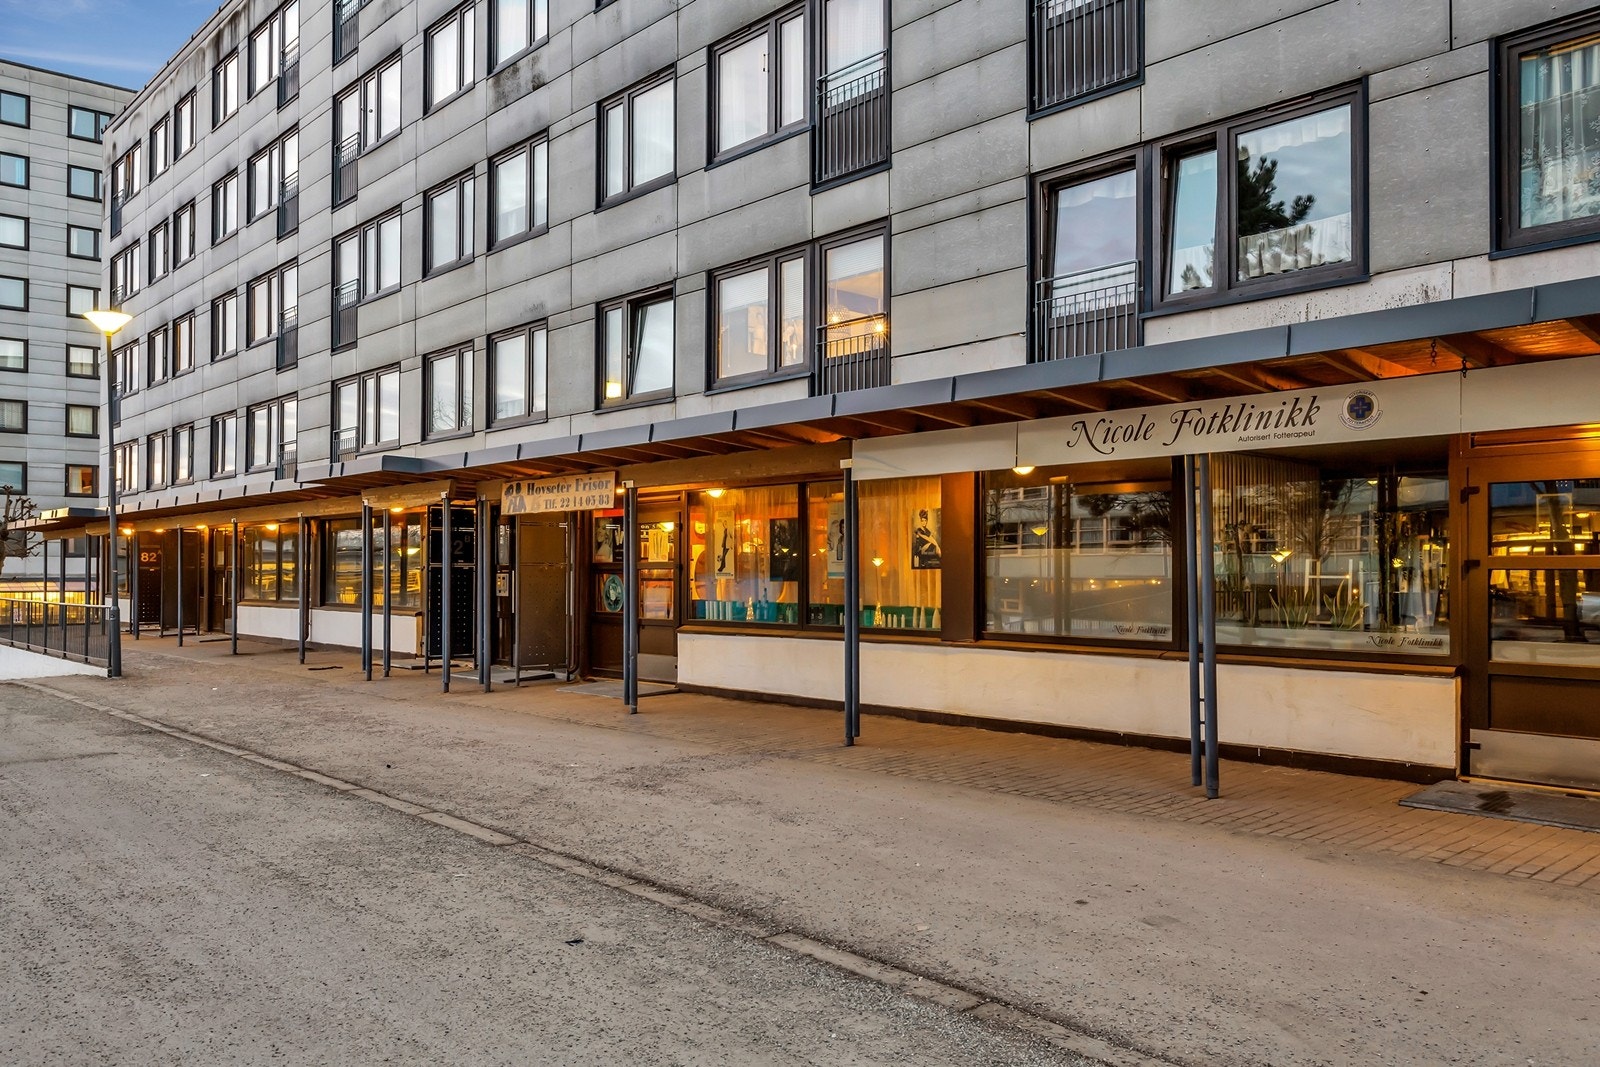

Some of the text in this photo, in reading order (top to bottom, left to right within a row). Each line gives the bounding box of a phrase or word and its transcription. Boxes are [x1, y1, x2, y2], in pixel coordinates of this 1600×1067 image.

[1066, 413, 1156, 455] Nicole
[1162, 395, 1321, 447] Fotklinikk
[1237, 430, 1316, 443] Autorisert Fotterapeut
[526, 482, 572, 496] Hovseter
[560, 498, 570, 508] 22
[1366, 635, 1395, 648] Nicole
